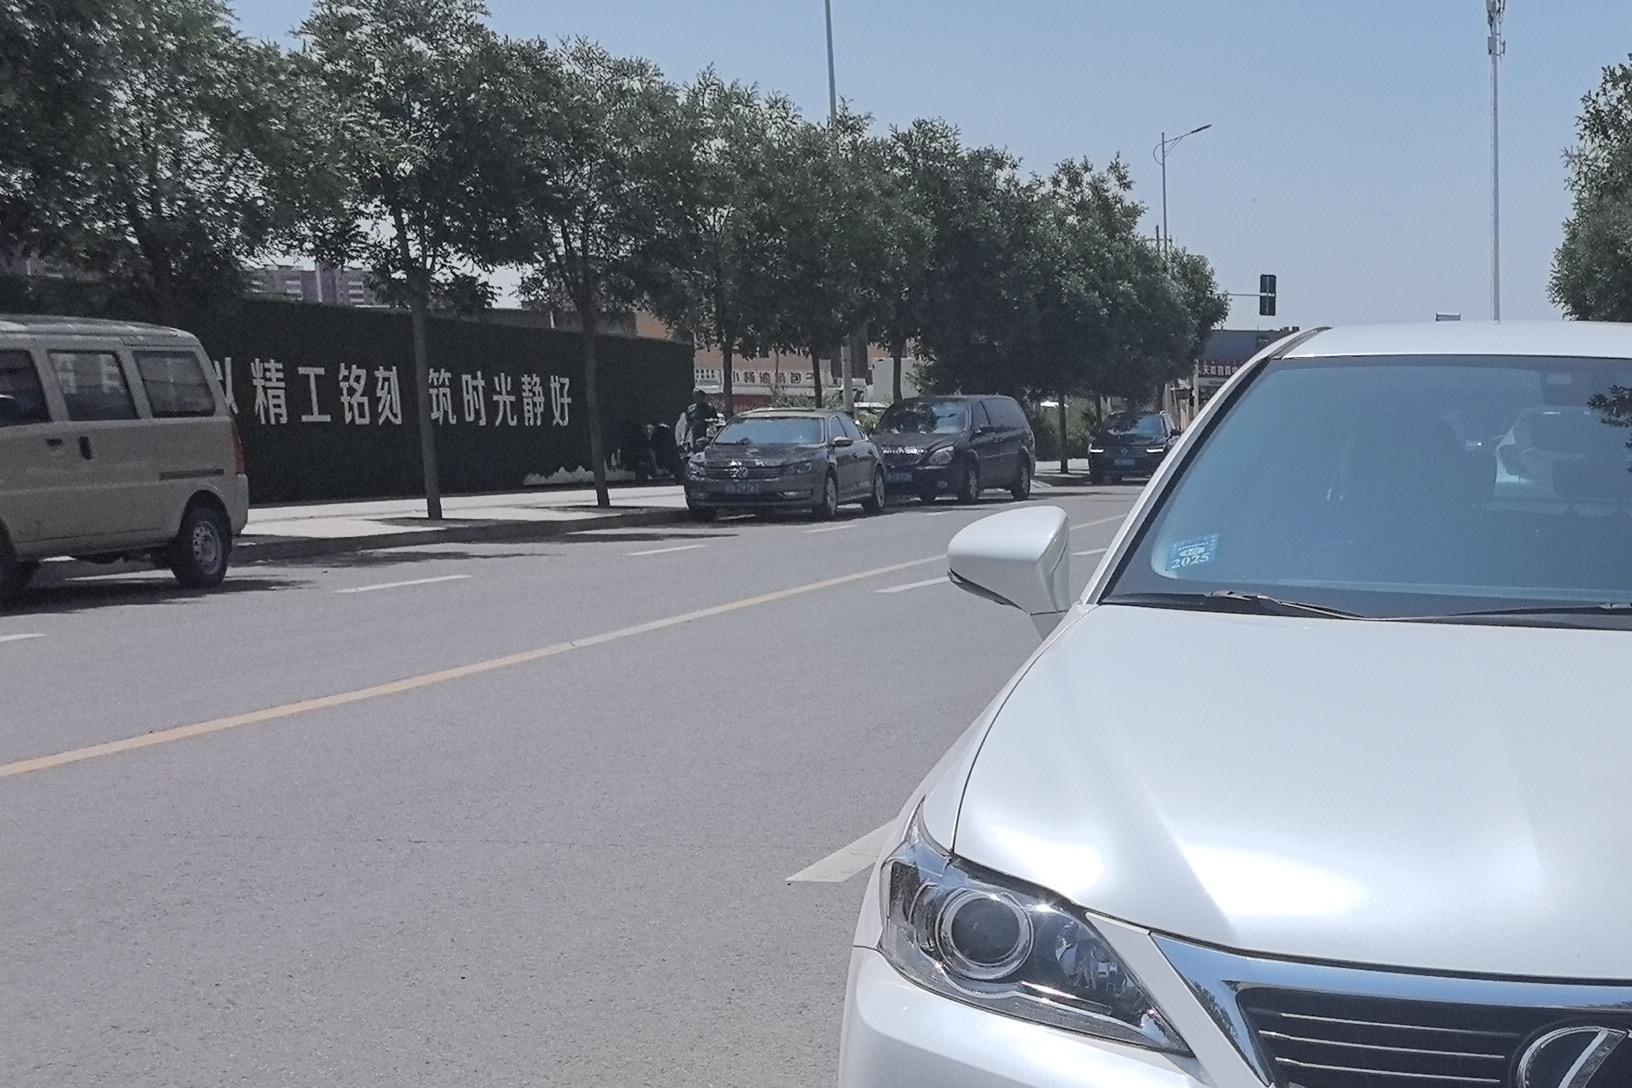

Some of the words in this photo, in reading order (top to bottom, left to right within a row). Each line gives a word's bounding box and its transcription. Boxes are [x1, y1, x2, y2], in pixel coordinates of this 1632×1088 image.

[428, 367, 573, 427] 筑时光静好
[1170, 552, 1210, 570] 2025
